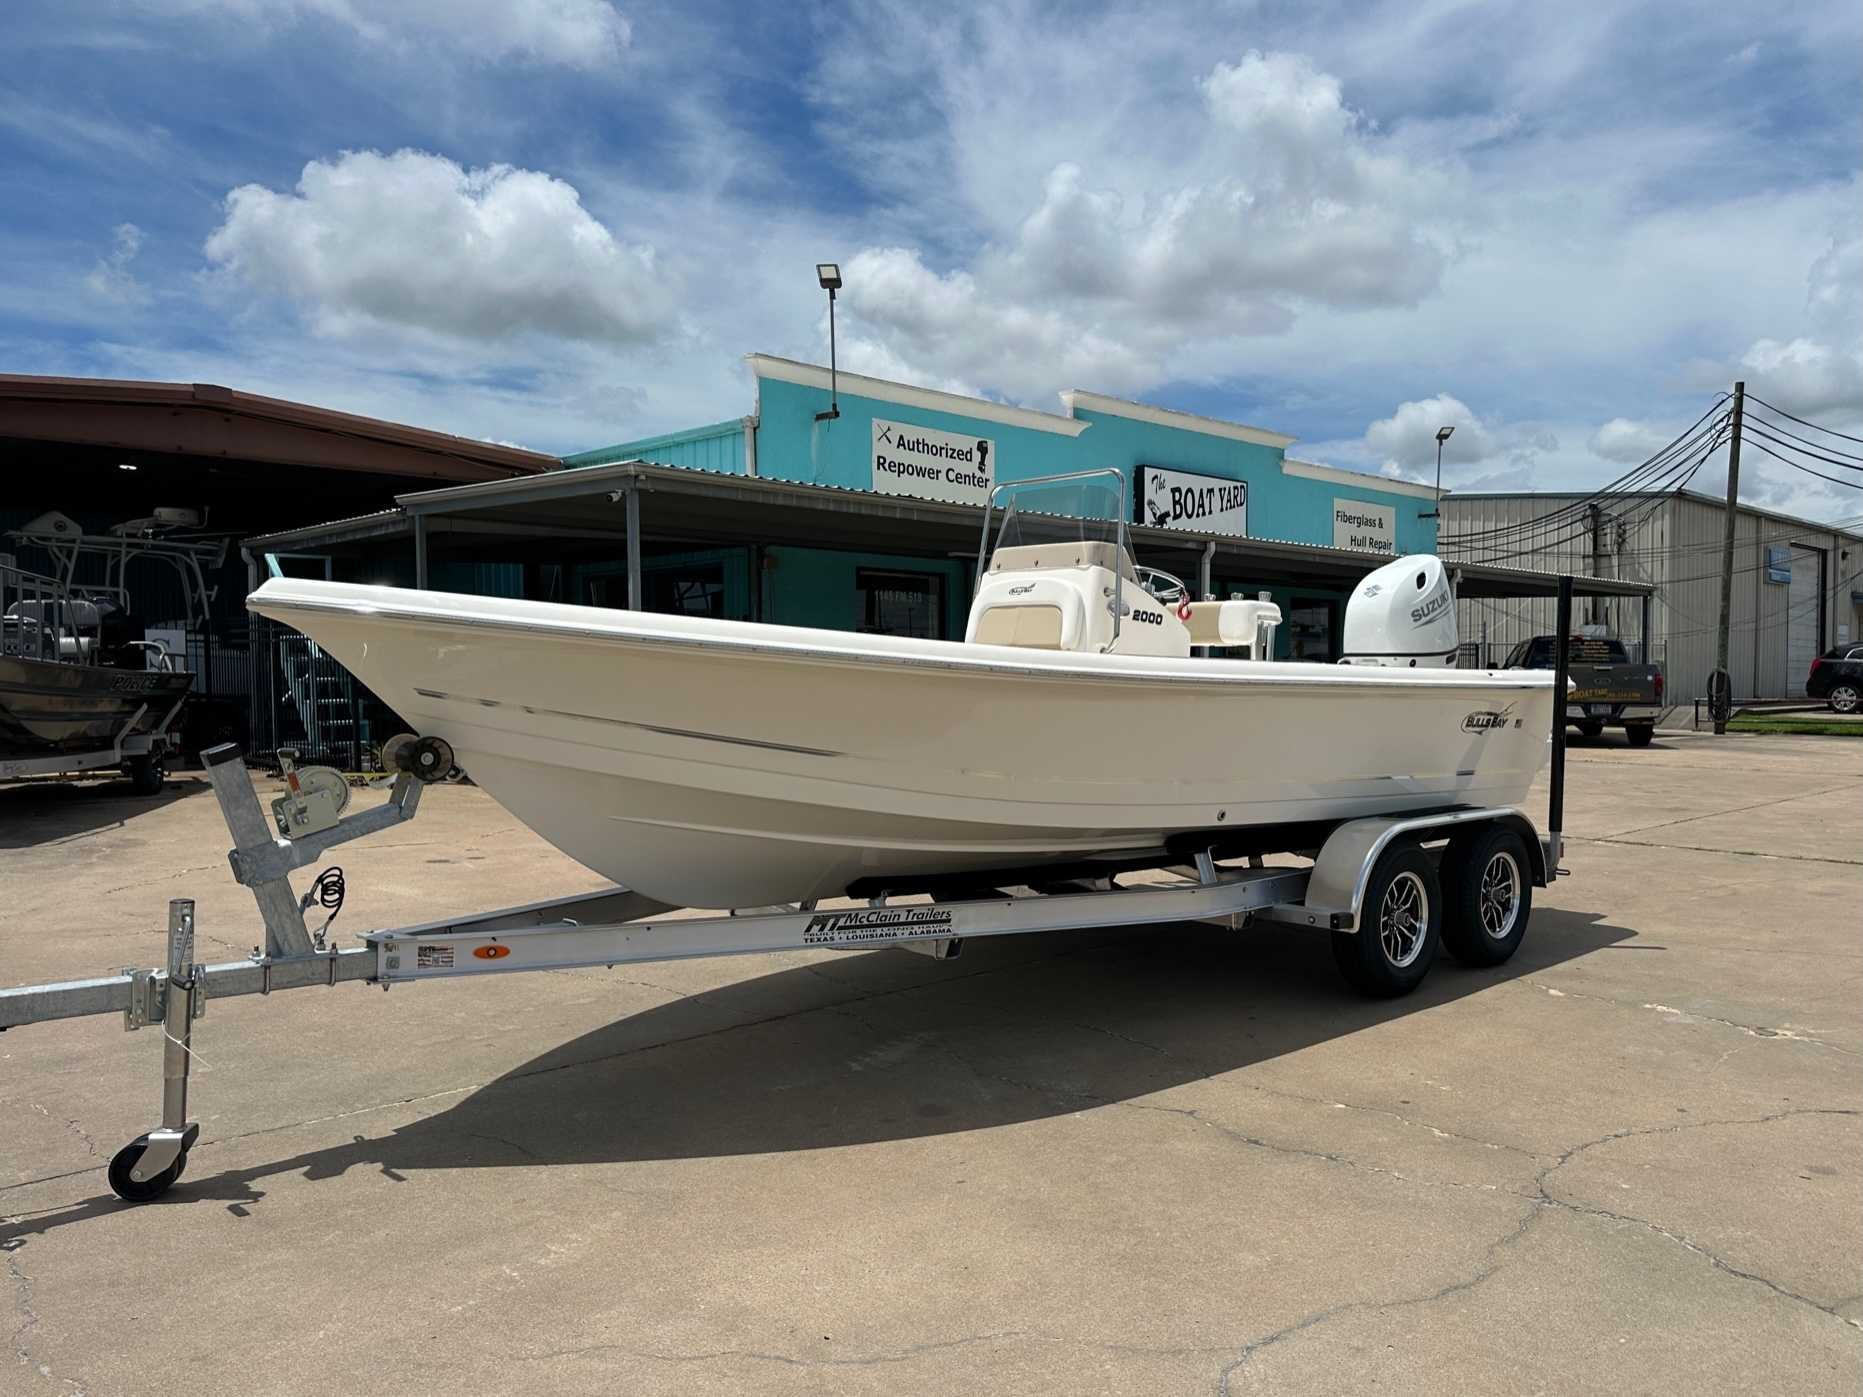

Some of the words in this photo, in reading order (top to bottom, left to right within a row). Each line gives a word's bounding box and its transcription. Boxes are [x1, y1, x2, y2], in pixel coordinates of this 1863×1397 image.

[896, 434, 973, 462] Authorized
[876, 455, 942, 481] Repower
[945, 467, 991, 489] Center
[1151, 473, 1167, 495] The
[1170, 486, 1215, 522] BOAT
[1218, 484, 1247, 513] YARD
[1335, 510, 1377, 528] Fiberglass
[1377, 517, 1384, 529] &
[1350, 534, 1367, 548] Hull
[1368, 536, 1393, 551] Repair
[1132, 609, 1164, 626] 2000
[843, 910, 902, 925] McClain
[904, 907, 953, 922] Trailers
[804, 935, 836, 944] TEXAS
[846, 931, 898, 941] LOUISIANA
[908, 927, 953, 936] ALABAMA
